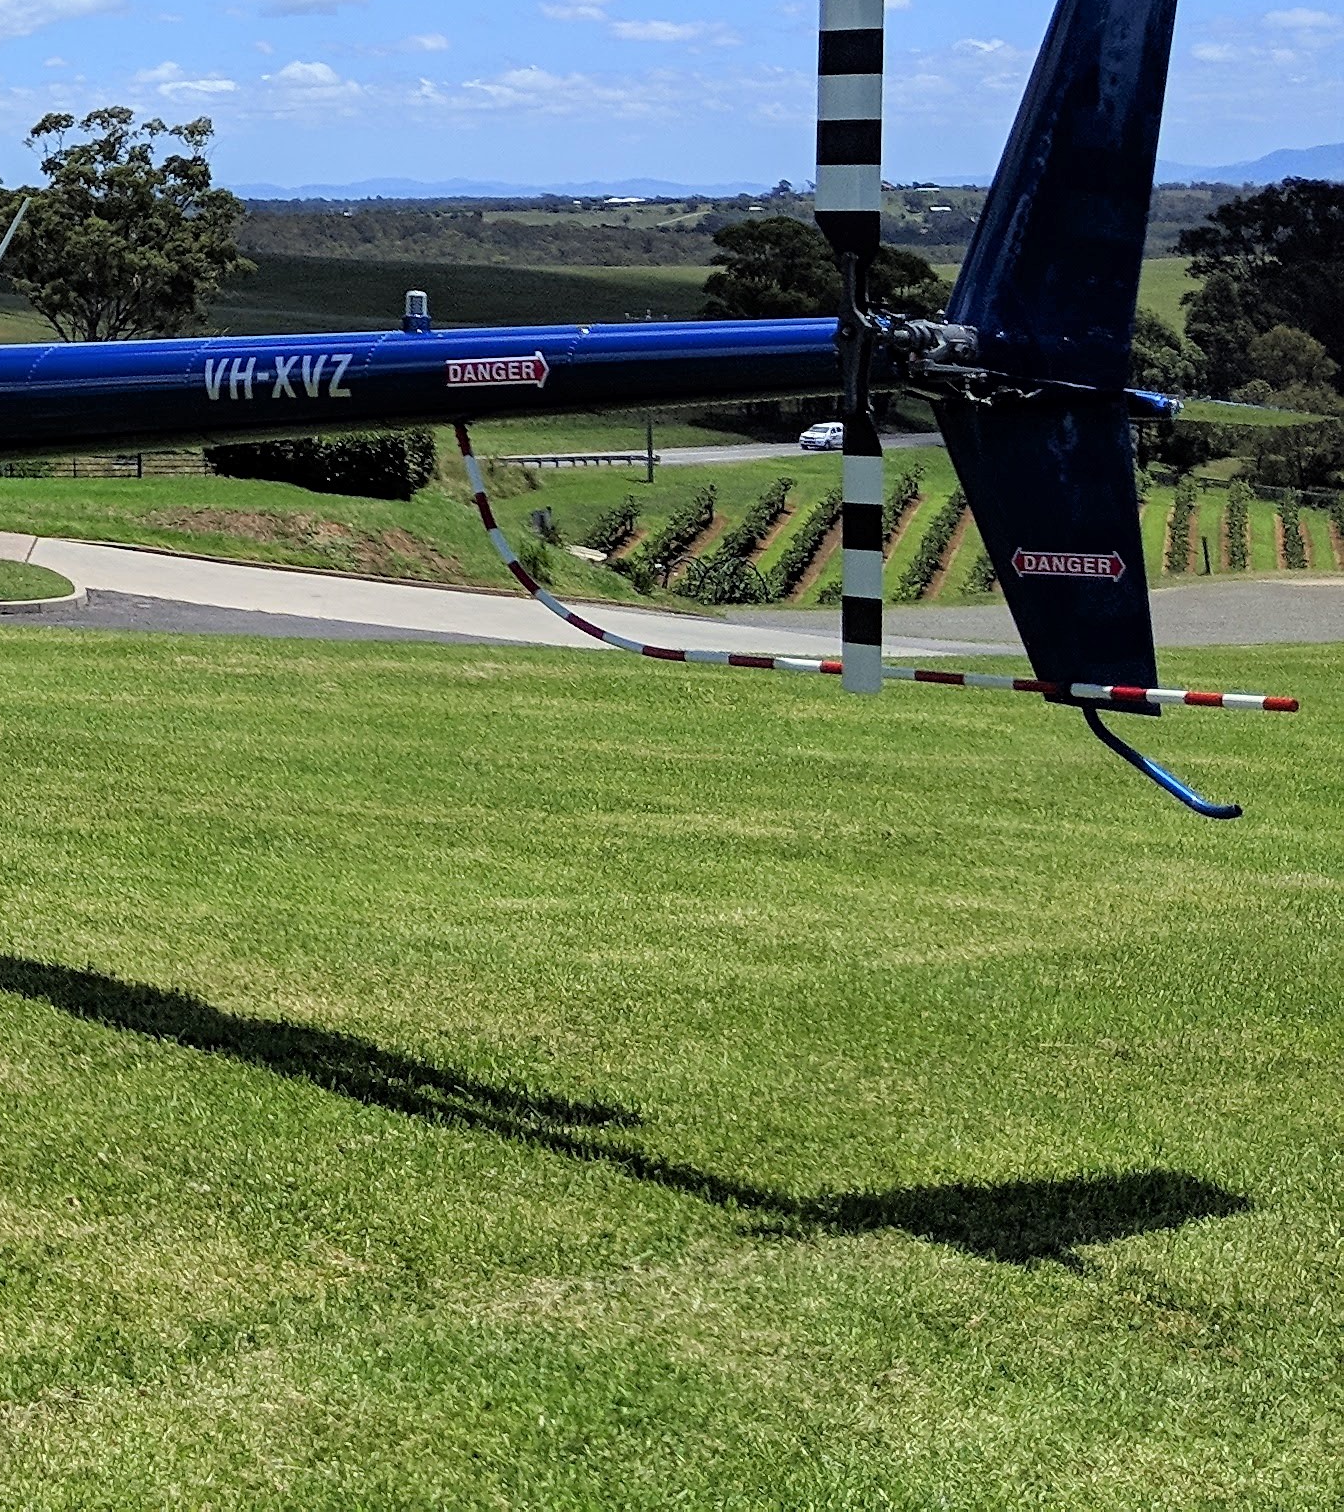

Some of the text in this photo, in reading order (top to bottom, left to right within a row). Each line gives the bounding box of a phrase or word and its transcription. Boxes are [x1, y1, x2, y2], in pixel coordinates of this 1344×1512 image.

[204, 353, 353, 401] VH-XVZ
[448, 359, 536, 382] DANGER
[1023, 555, 1112, 574] DANGER
